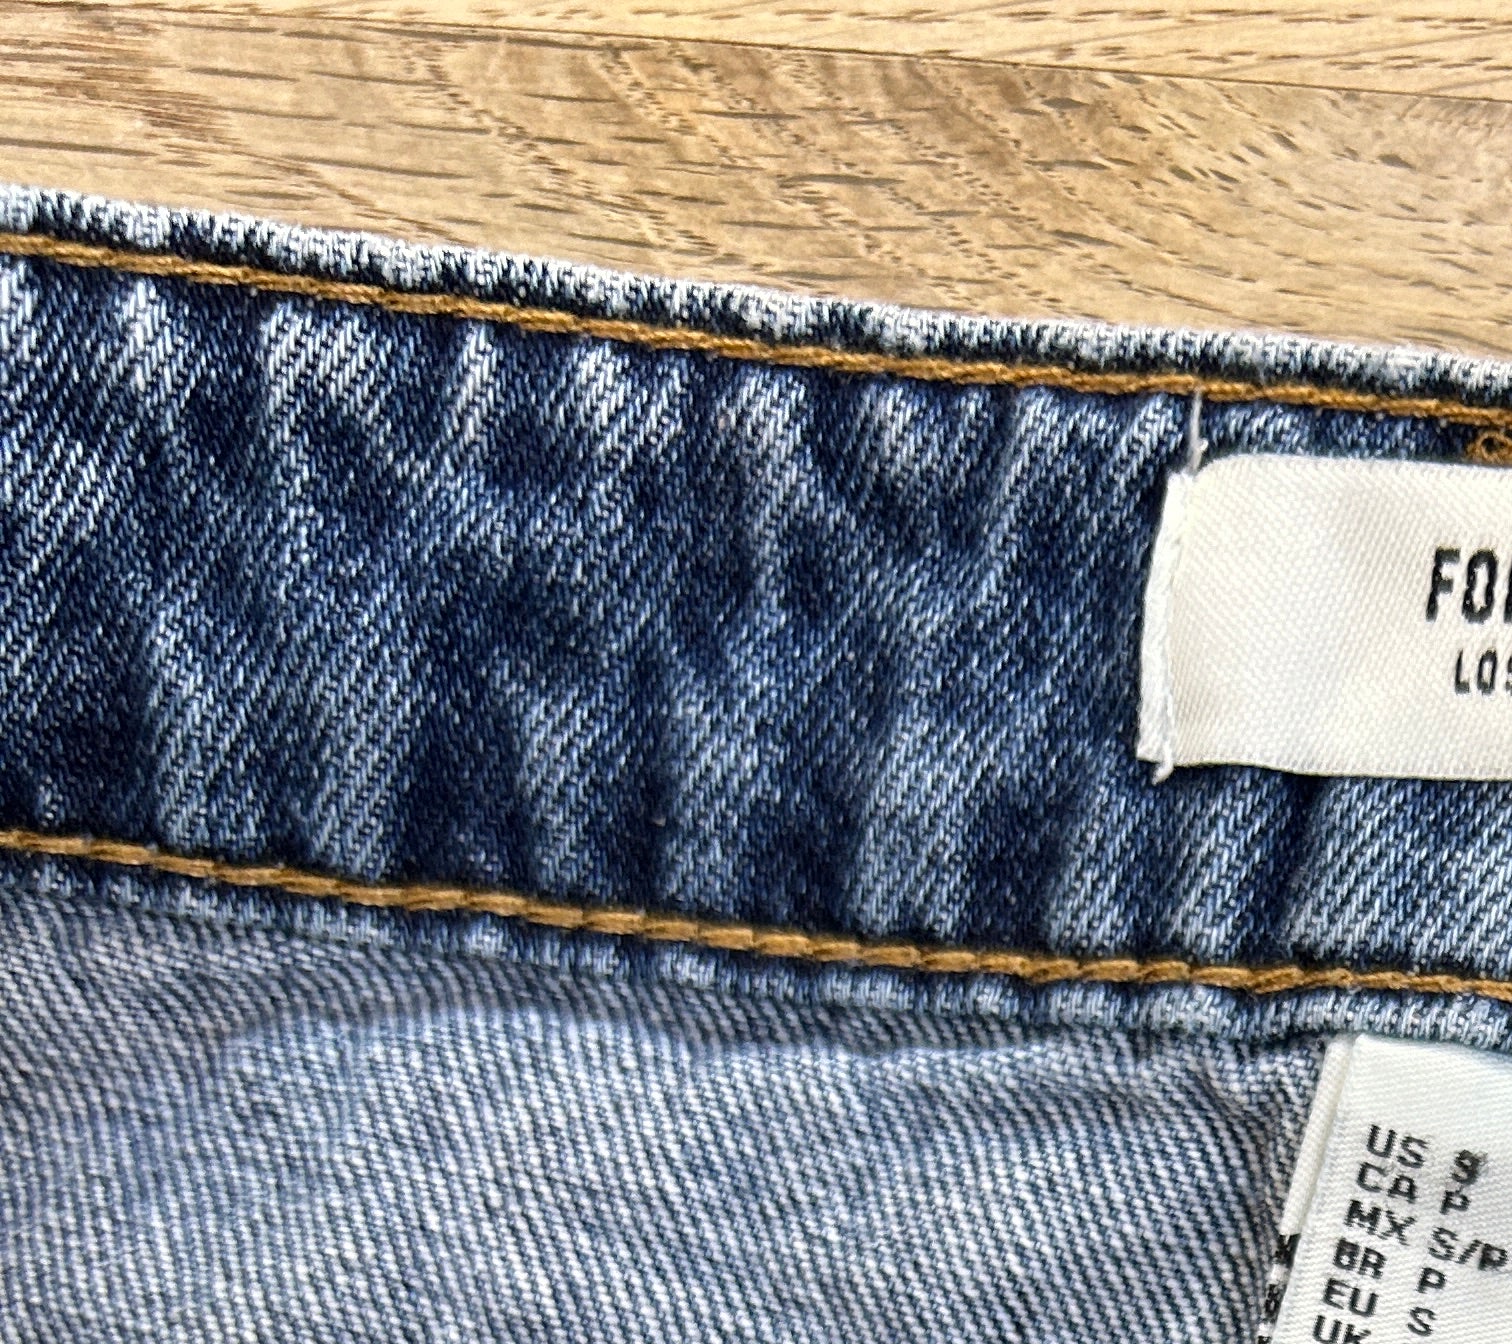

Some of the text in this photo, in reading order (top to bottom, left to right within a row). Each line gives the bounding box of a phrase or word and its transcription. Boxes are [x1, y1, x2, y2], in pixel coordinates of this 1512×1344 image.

[1365, 1123, 1428, 1170] US
[1355, 1160, 1473, 1217] CA P
[1343, 1198, 1509, 1273] MX S/P
[1331, 1236, 1447, 1295] BR P
[1322, 1276, 1437, 1337] EU S
